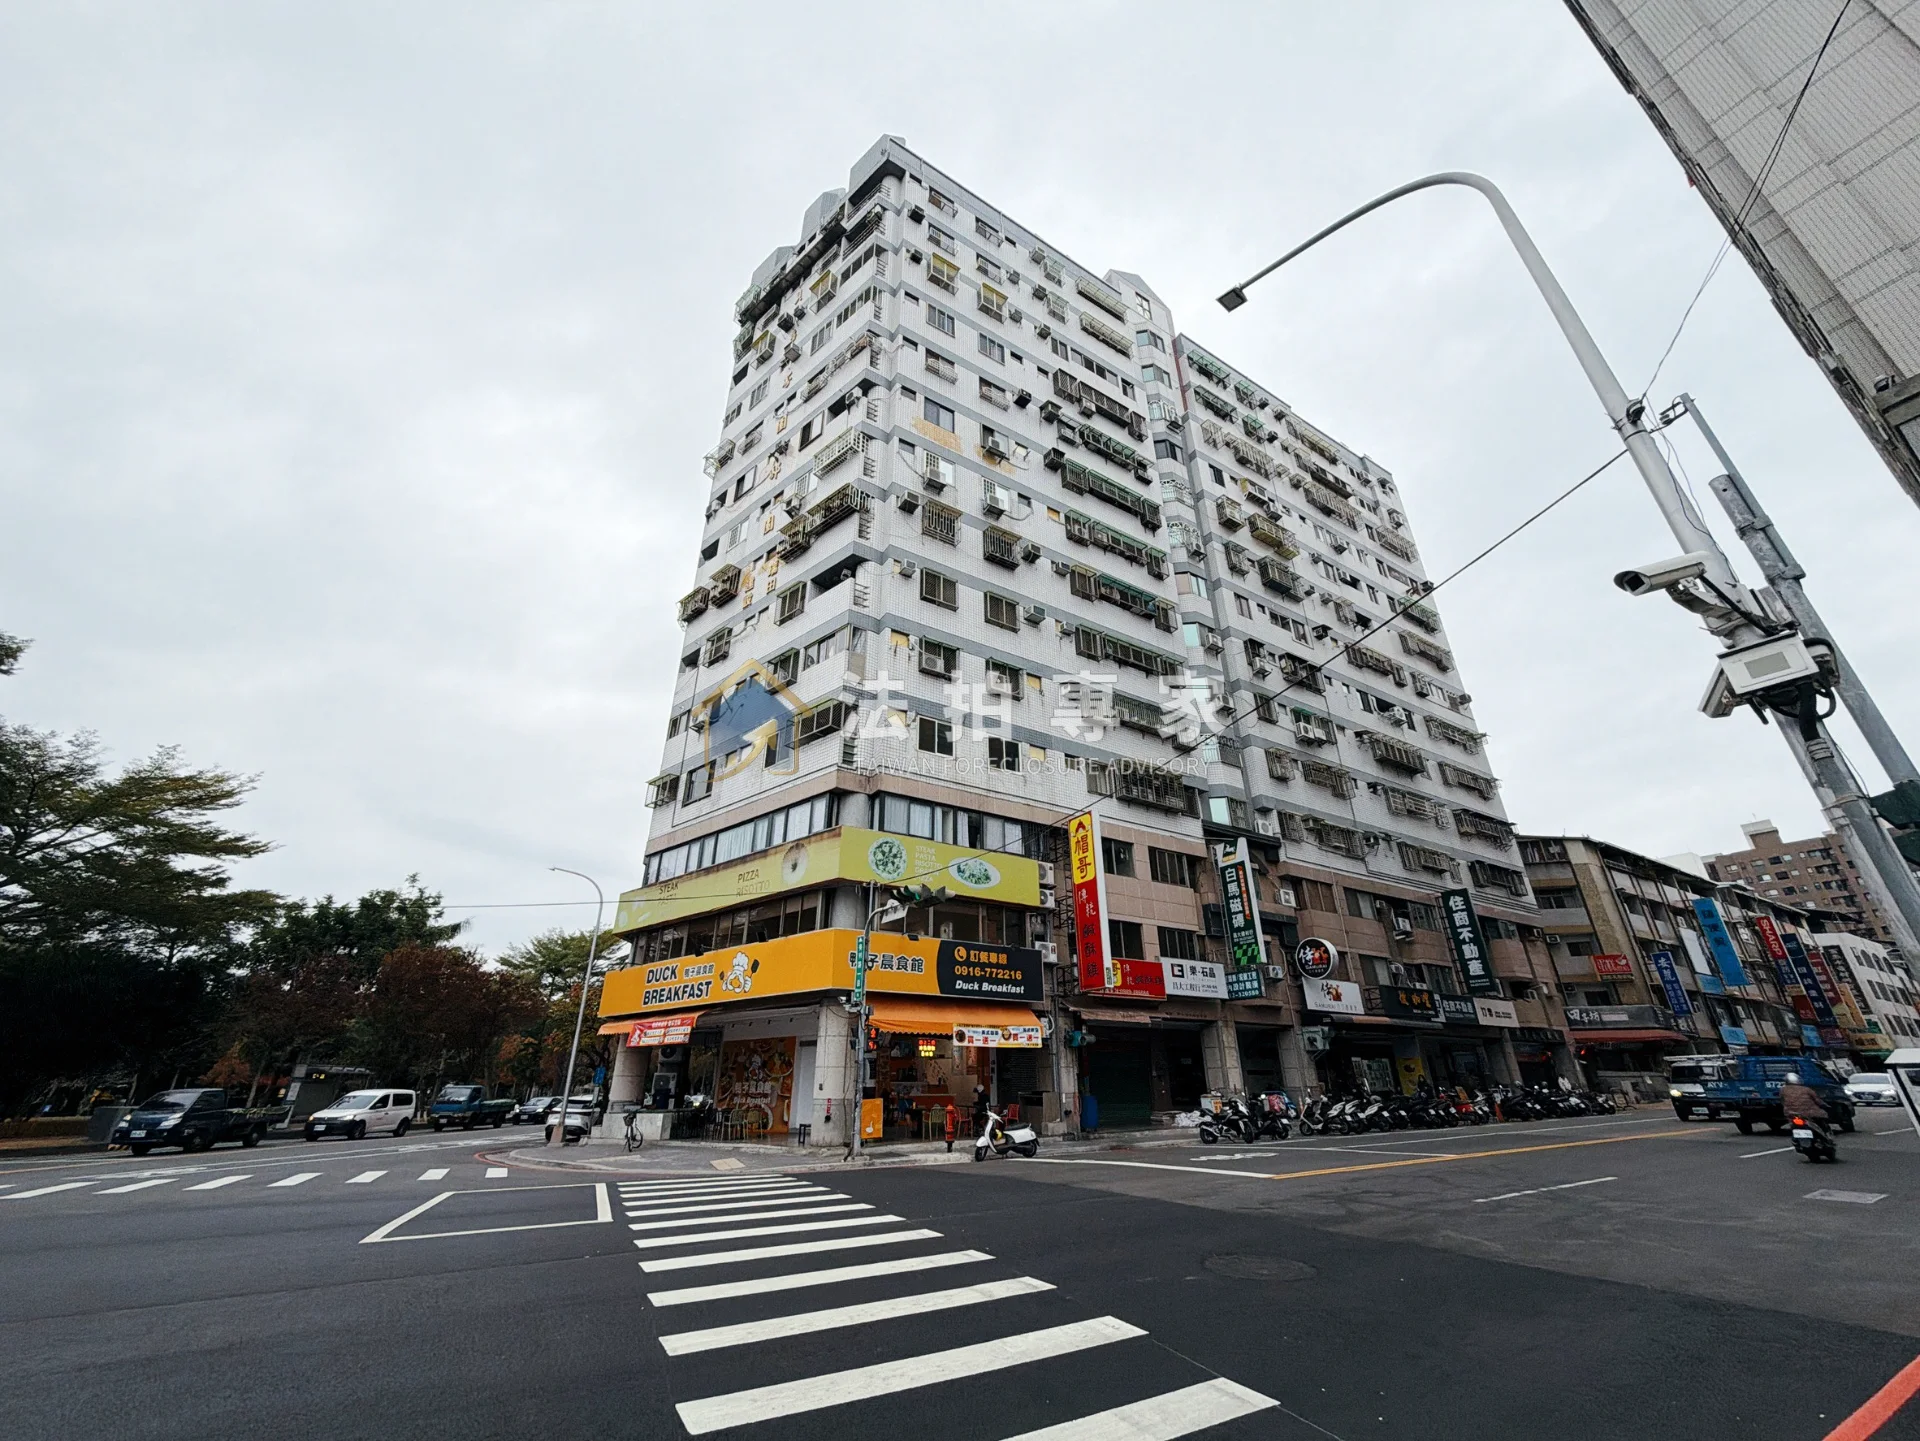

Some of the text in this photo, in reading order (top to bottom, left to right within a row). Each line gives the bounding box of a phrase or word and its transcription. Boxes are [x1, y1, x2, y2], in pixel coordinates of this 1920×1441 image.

[738, 868, 760, 883] PIZZA
[658, 881, 679, 894] STEAK
[1448, 895, 1485, 976] 住商不動產
[1760, 919, 1783, 956] SHARP
[969, 950, 1008, 964] 訂餐專線
[646, 964, 679, 984] DUCK
[954, 965, 1023, 980] 0916-772216
[643, 980, 713, 1006] BREAKFAST
[955, 980, 1025, 994] Duck Breakfast
